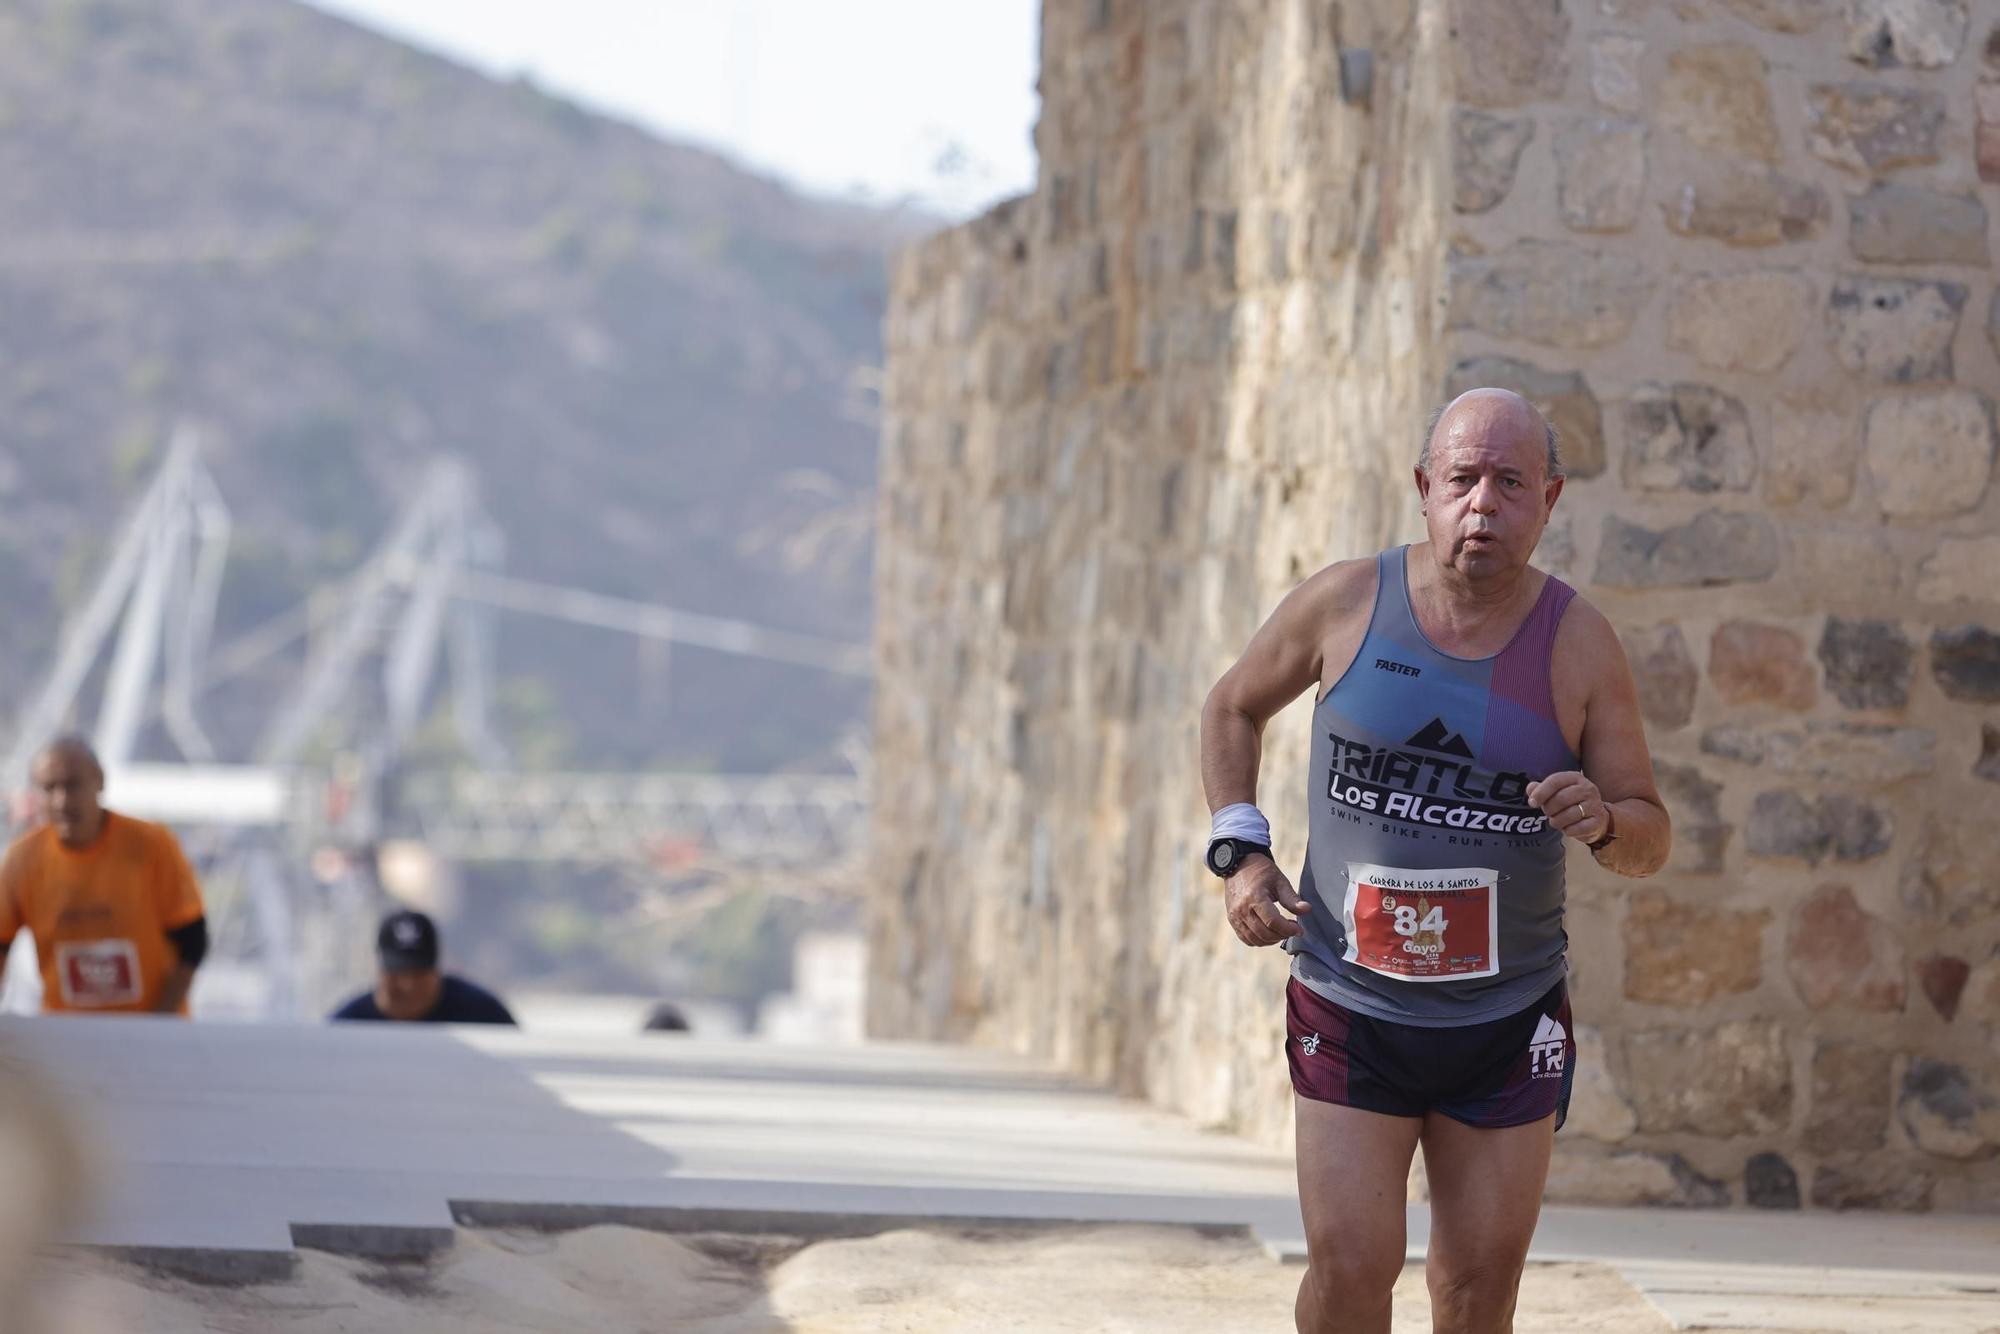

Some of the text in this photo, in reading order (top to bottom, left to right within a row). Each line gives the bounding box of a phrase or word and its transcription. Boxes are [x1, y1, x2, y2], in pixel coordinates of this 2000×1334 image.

[1376, 659, 1421, 678] FASTER
[1330, 775, 1379, 811] Los
[1330, 806, 1362, 825] SWIM
[1382, 823, 1420, 839] BIKE
[1448, 835, 1483, 848] RUN
[1369, 875, 1480, 890] CARRERA DE LOS 4 SANTOS
[1393, 905, 1449, 936] 84
[1402, 940, 1438, 956] Goyo
